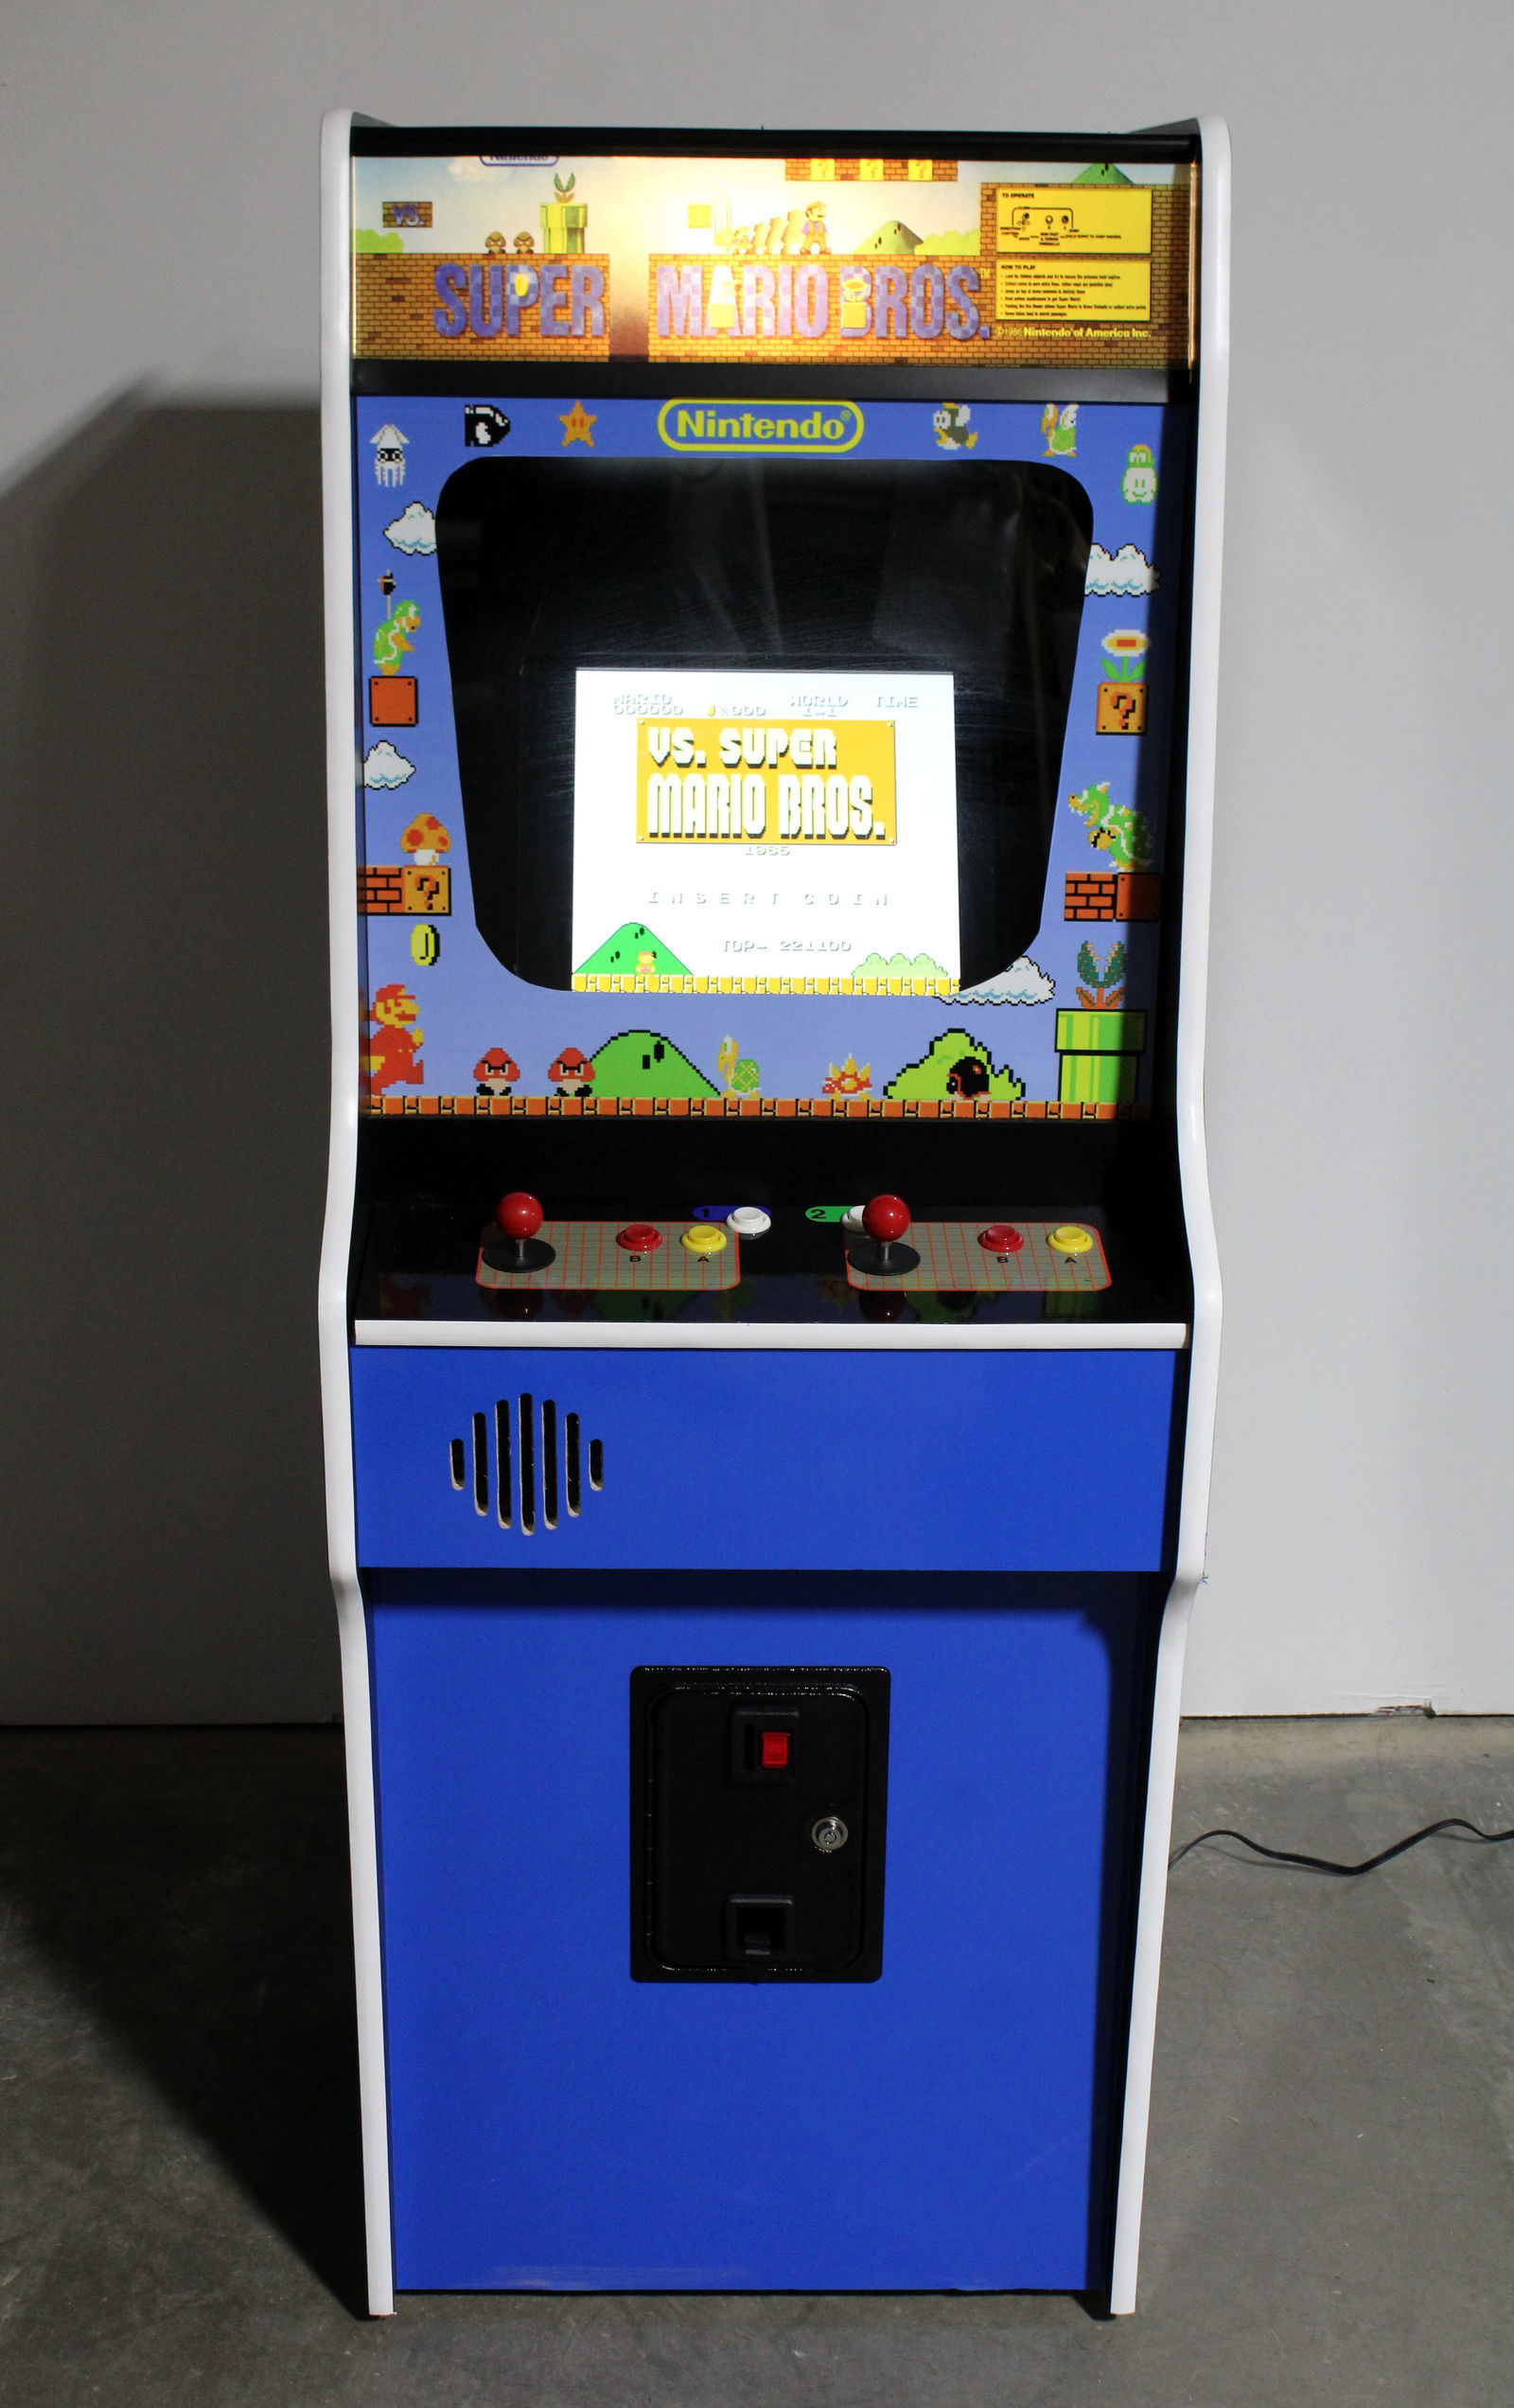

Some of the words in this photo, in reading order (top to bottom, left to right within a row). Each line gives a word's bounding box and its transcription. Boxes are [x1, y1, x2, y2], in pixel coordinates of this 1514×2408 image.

[393, 204, 425, 227] VS.
[433, 262, 606, 338] SUPER
[656, 264, 829, 339] MARIO
[839, 264, 991, 340] BROS.
[1085, 328, 1130, 337] America
[1132, 328, 1152, 338] Inc.
[677, 410, 845, 440] Nintendo
[789, 696, 848, 707] WORLD
[876, 697, 919, 708] TIME
[647, 727, 707, 768] VS.
[719, 727, 837, 770] SUPER
[647, 773, 766, 840] MARIO
[778, 774, 886, 841] BROS.
[779, 940, 852, 952] 221100
[701, 1208, 709, 1218] 1
[811, 1209, 826, 1219] 2
